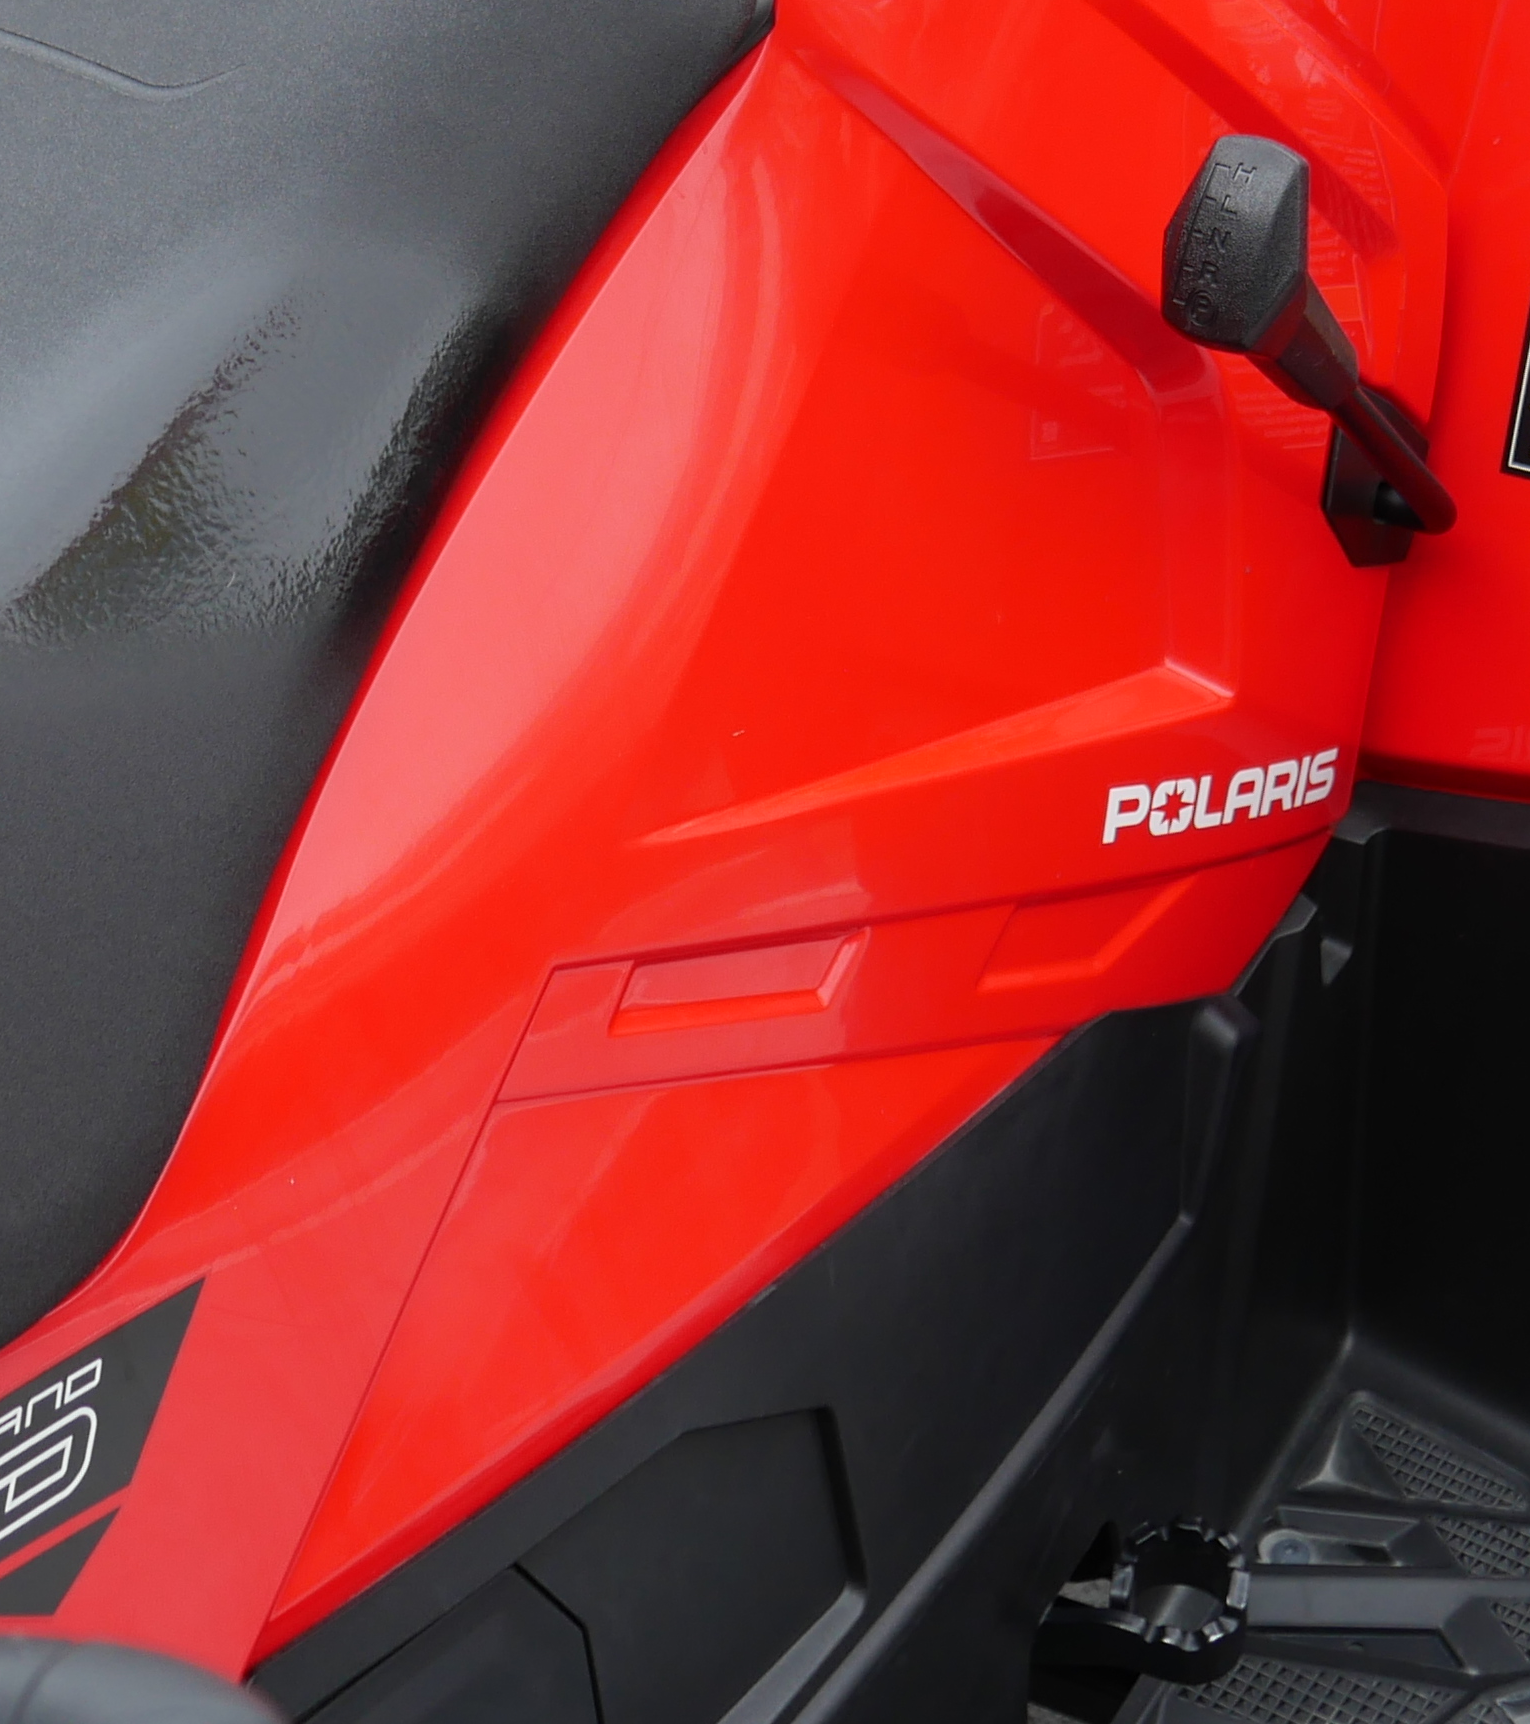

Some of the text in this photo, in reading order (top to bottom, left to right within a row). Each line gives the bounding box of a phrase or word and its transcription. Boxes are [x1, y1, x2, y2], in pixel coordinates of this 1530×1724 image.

[1232, 162, 1257, 187] H
[1220, 194, 1238, 219] L
[1207, 226, 1231, 254] N
[1101, 747, 1339, 845] POLARIS
